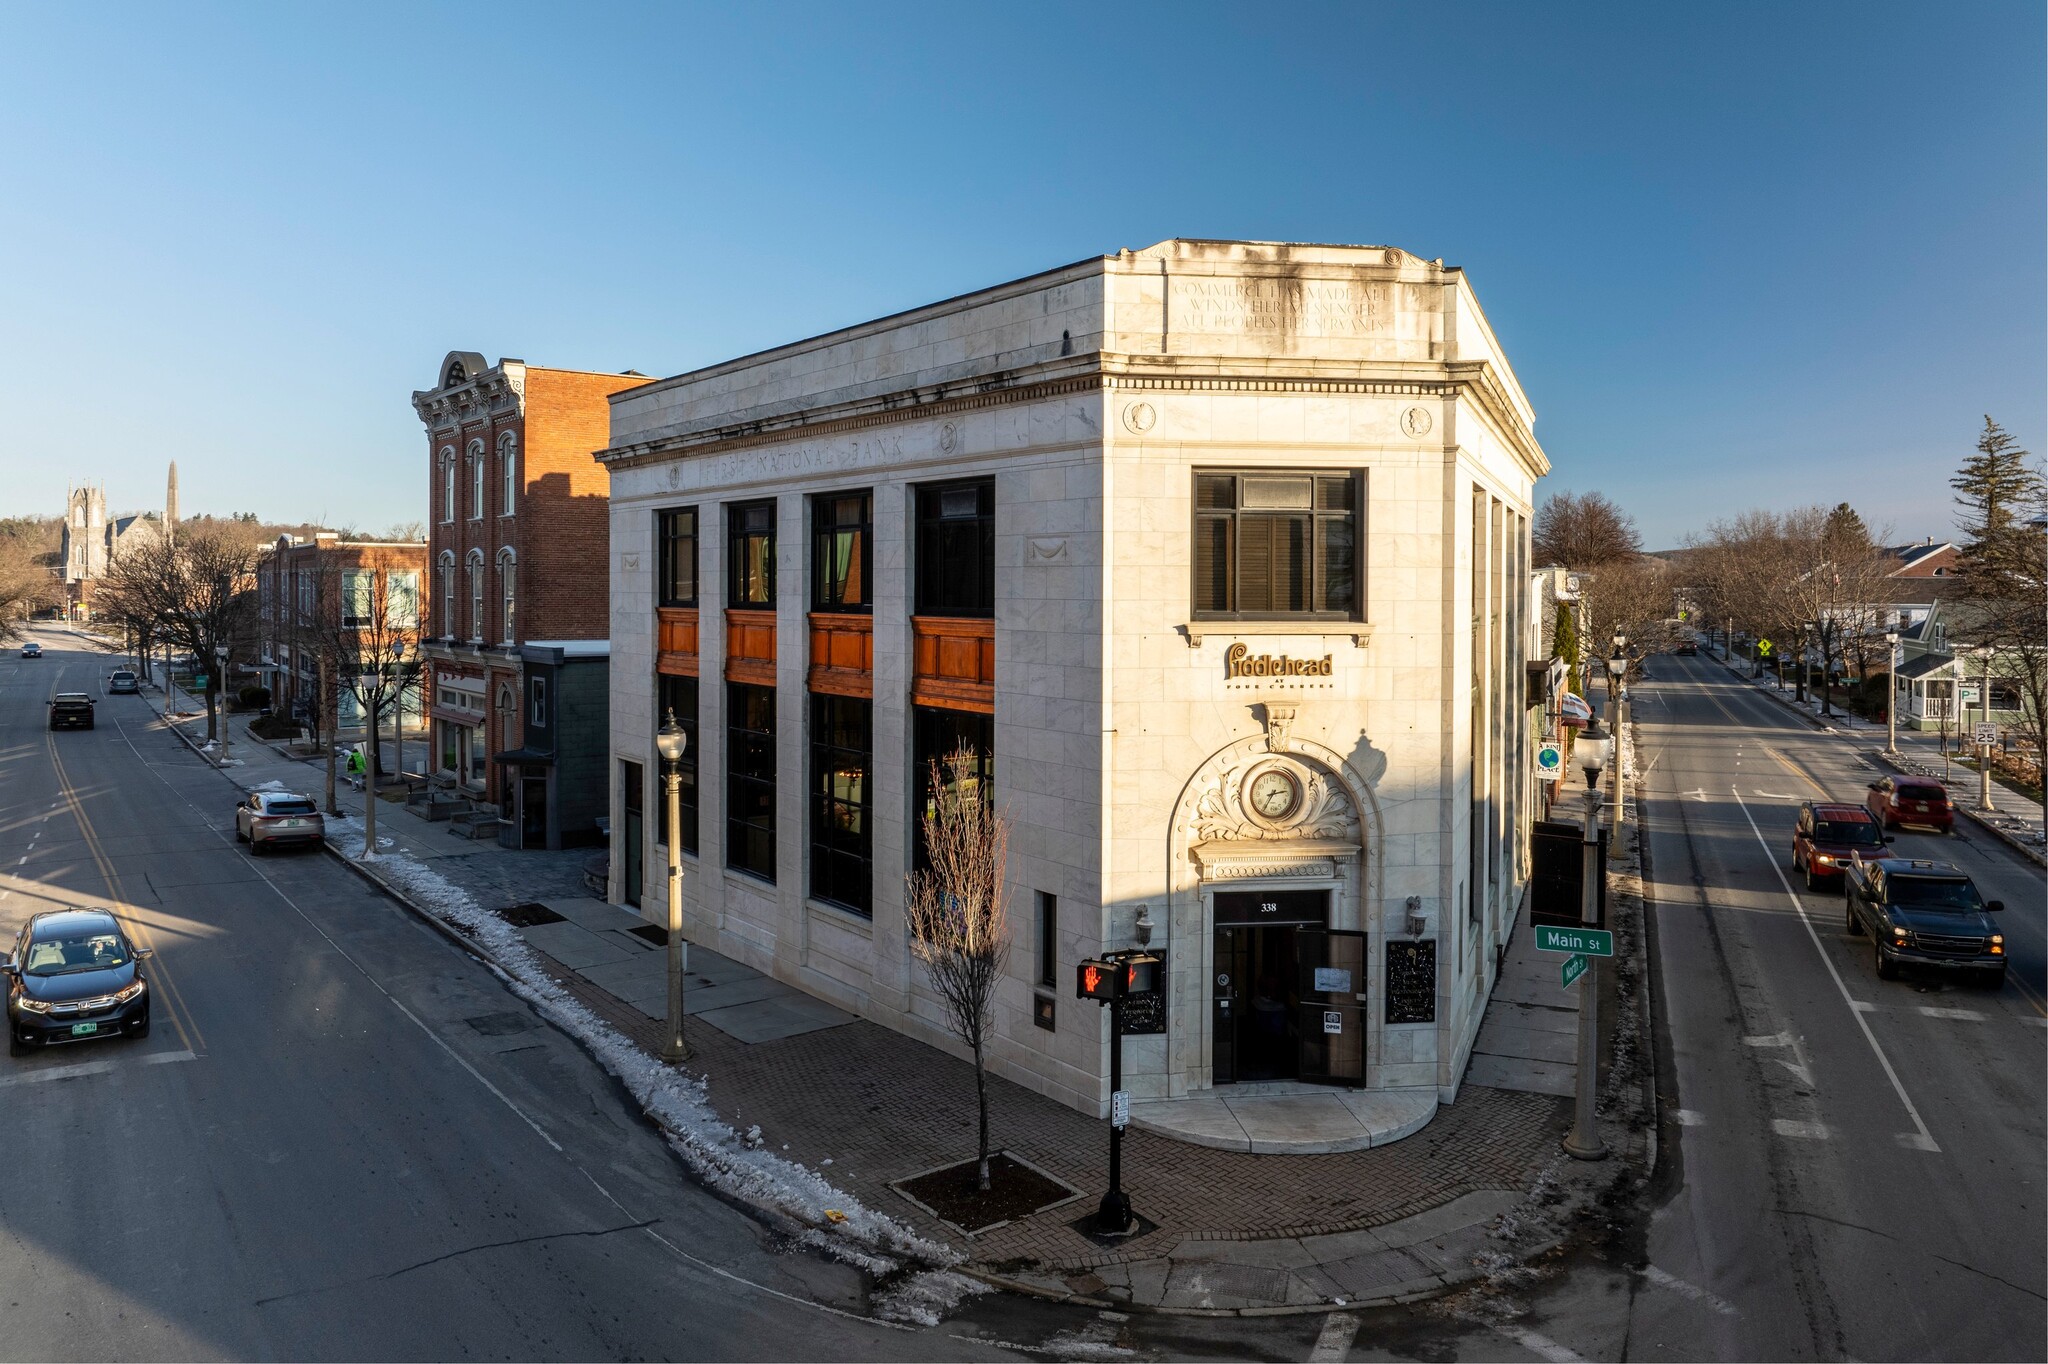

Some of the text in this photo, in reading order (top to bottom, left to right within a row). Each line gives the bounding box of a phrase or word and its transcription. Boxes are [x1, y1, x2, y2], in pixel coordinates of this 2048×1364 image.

[1174, 282, 1391, 301] COMMERCE HAS MADE ALL
[1190, 298, 1376, 316] WINDS HER MESSENGER
[1183, 313, 1206, 327] ALL
[1282, 316, 1309, 330] HER
[1315, 318, 1385, 332] SERVANTS
[705, 435, 903, 482] FIRST NATIONAL BANK
[1978, 734, 1995, 742] 25
[1260, 902, 1277, 913] 338
[1547, 931, 1600, 950] Main St
[1565, 959, 1579, 981] North
